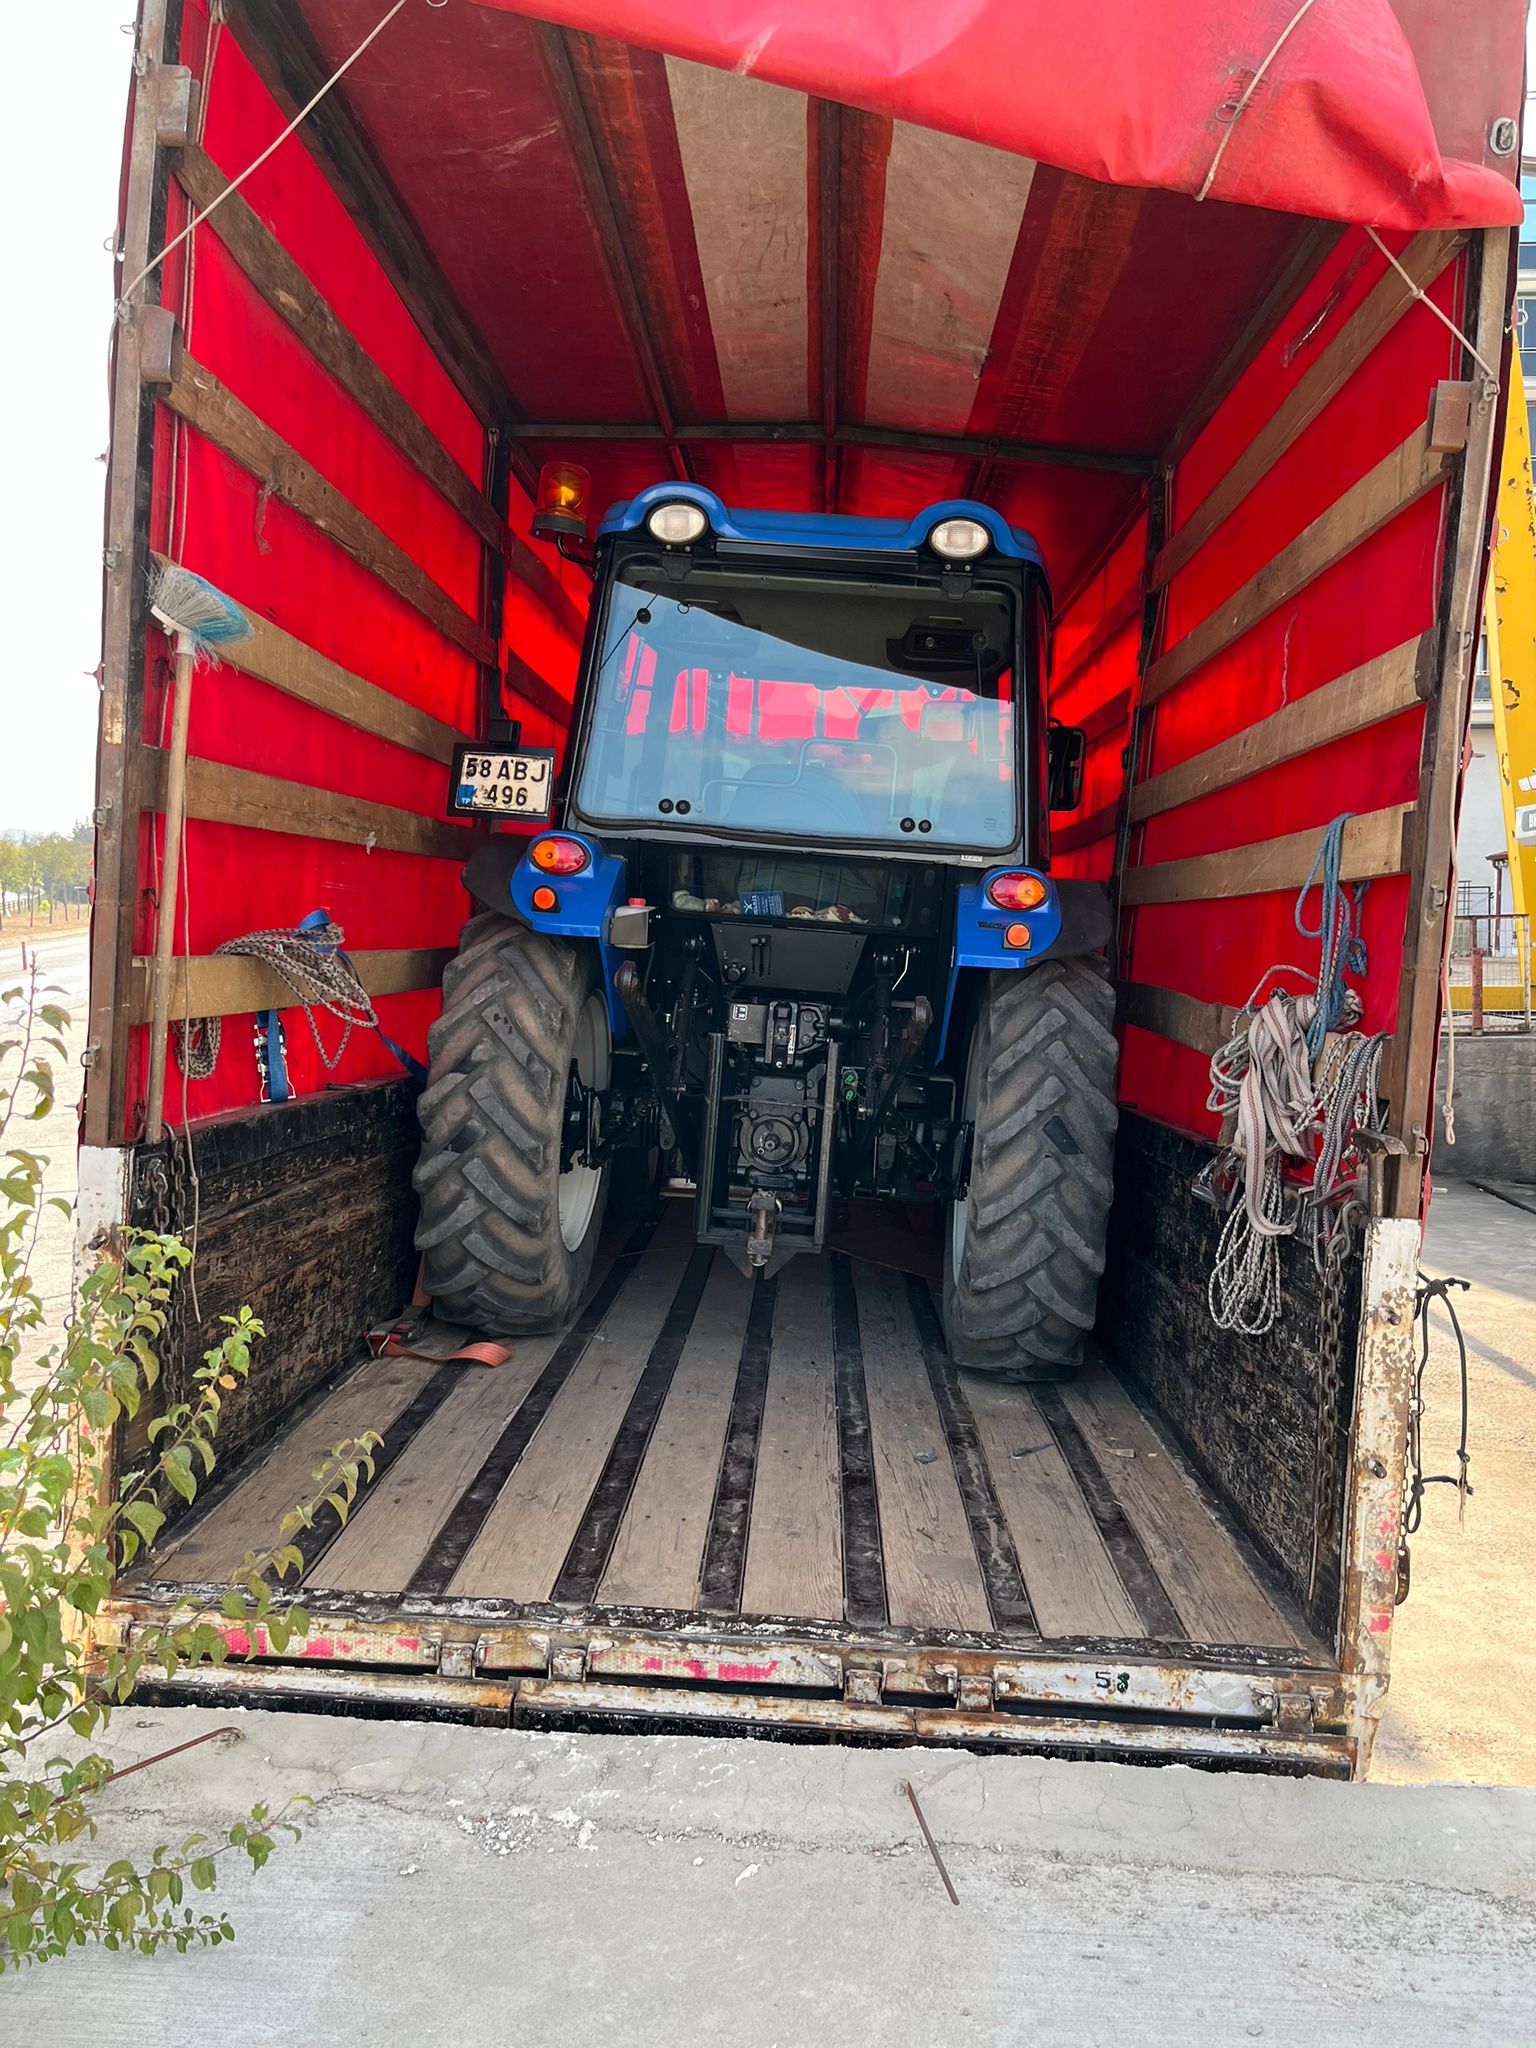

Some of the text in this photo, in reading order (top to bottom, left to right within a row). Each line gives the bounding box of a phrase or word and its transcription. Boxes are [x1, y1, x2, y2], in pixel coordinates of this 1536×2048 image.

[466, 758, 546, 783] 58 ABJ
[487, 784, 528, 806] 496
[1095, 1671, 1131, 1694] 58
